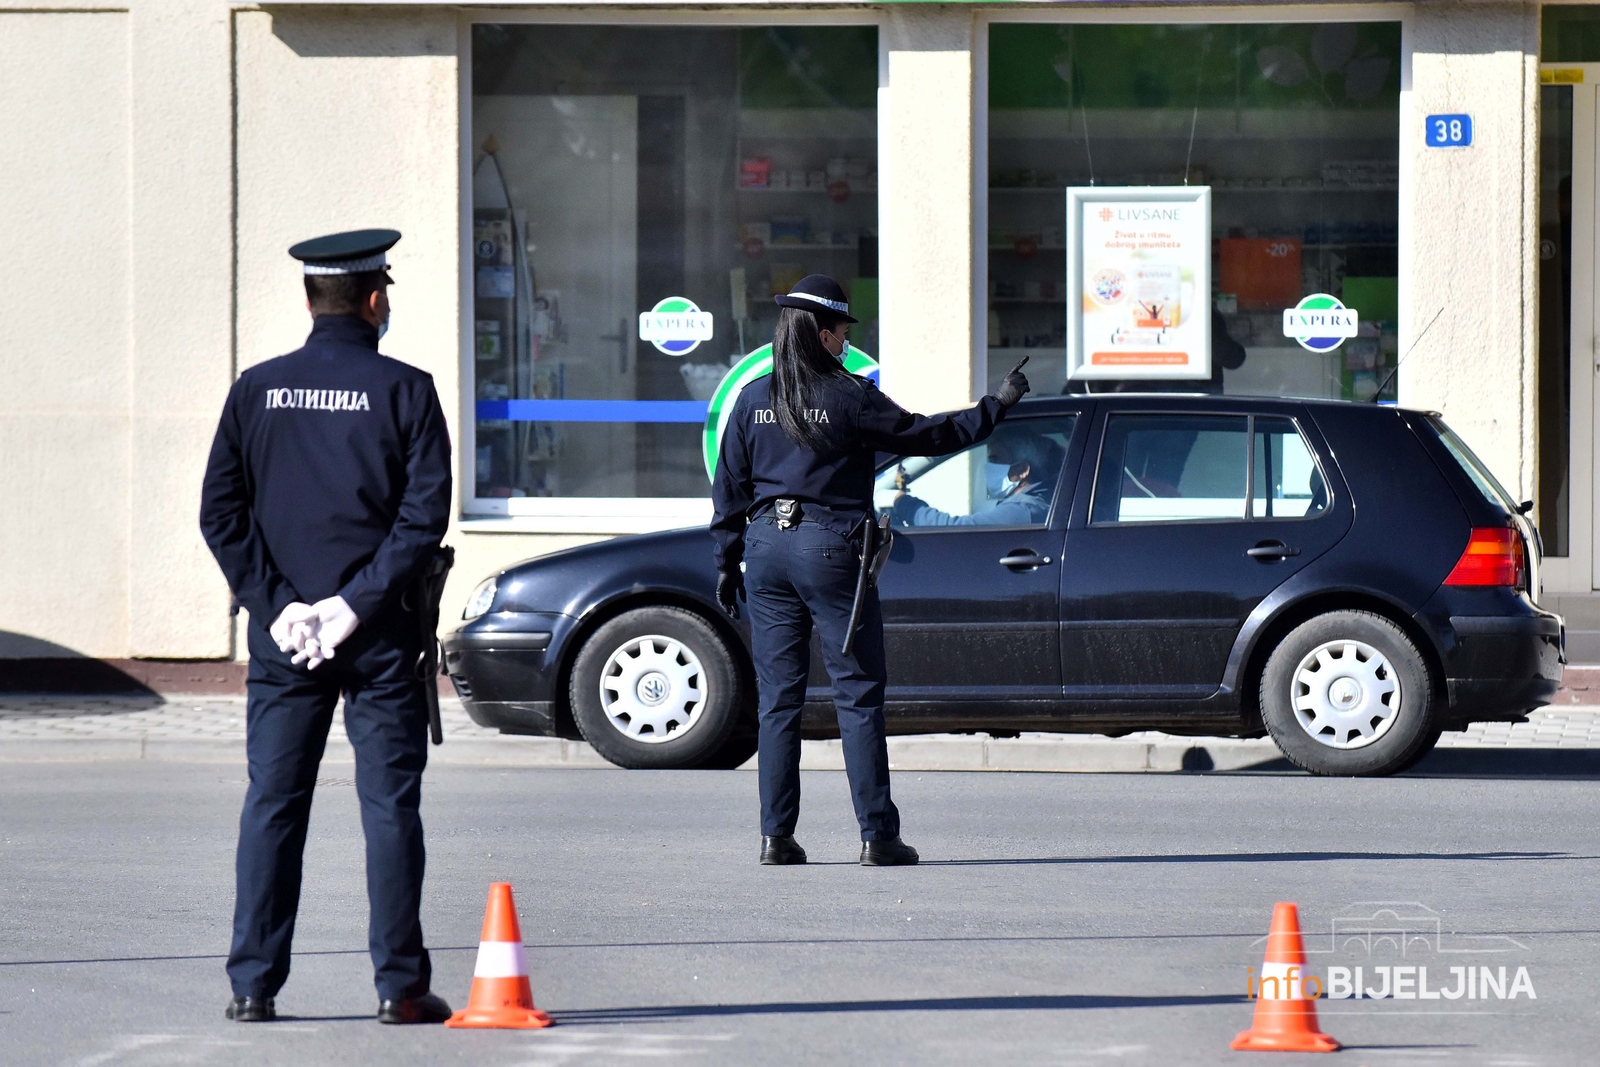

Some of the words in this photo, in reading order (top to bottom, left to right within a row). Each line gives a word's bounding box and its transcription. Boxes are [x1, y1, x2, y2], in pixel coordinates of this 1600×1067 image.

[1434, 119, 1462, 143] 38
[1118, 208, 1180, 221] LIVSANE
[1104, 241, 1136, 250] dobrog
[645, 318, 706, 329] EXPERA
[1289, 315, 1352, 326] EXPERA
[265, 387, 370, 412] ПОЛИЦИЈА
